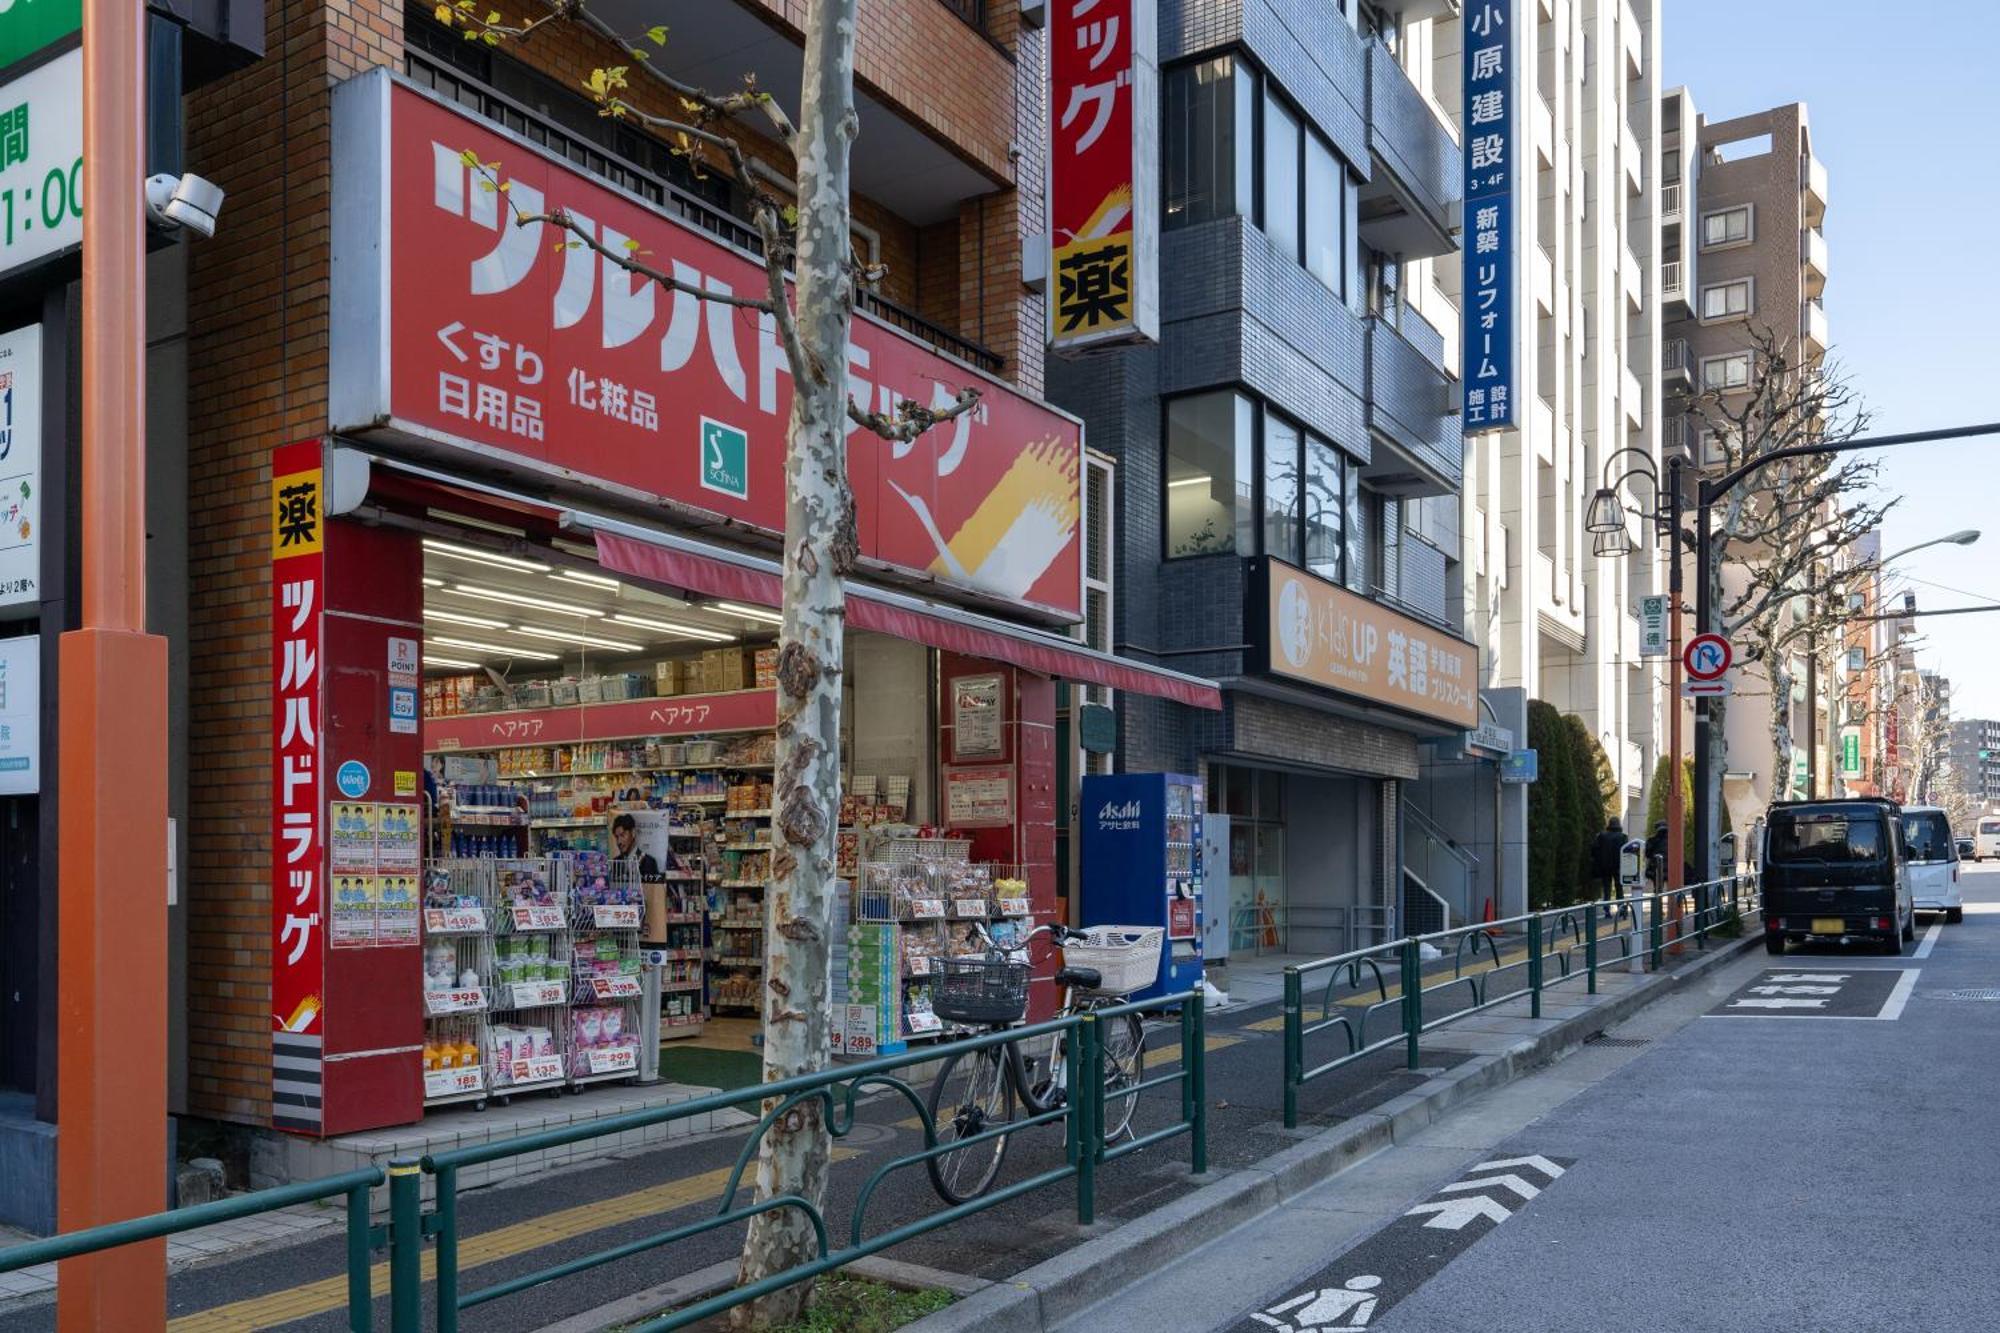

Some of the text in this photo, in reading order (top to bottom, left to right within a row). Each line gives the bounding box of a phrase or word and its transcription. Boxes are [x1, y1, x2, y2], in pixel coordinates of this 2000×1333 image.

[1061, 0, 1131, 155] ッグ
[1471, 4, 1504, 170] 小原建設
[1059, 245, 1128, 333] 薬
[1476, 205, 1499, 379] 新築 リフォーム
[436, 321, 544, 385] くすり
[439, 371, 544, 441] 日用品
[567, 367, 659, 432] 化粧品
[1468, 389, 1485, 423] 施工
[1490, 385, 1508, 420] 設計
[280, 482, 316, 548] 薬
[1353, 619, 1378, 666] UP
[1387, 629, 1428, 696] 英語
[492, 719, 544, 738] ヘアケア
[650, 705, 711, 725] ヘアケア
[281, 579, 319, 967] ツルハドラッグ
[1098, 800, 1141, 819] Asahi
[1099, 820, 1140, 830] アサヒ飲料
[850, 1036, 873, 1048] 289
